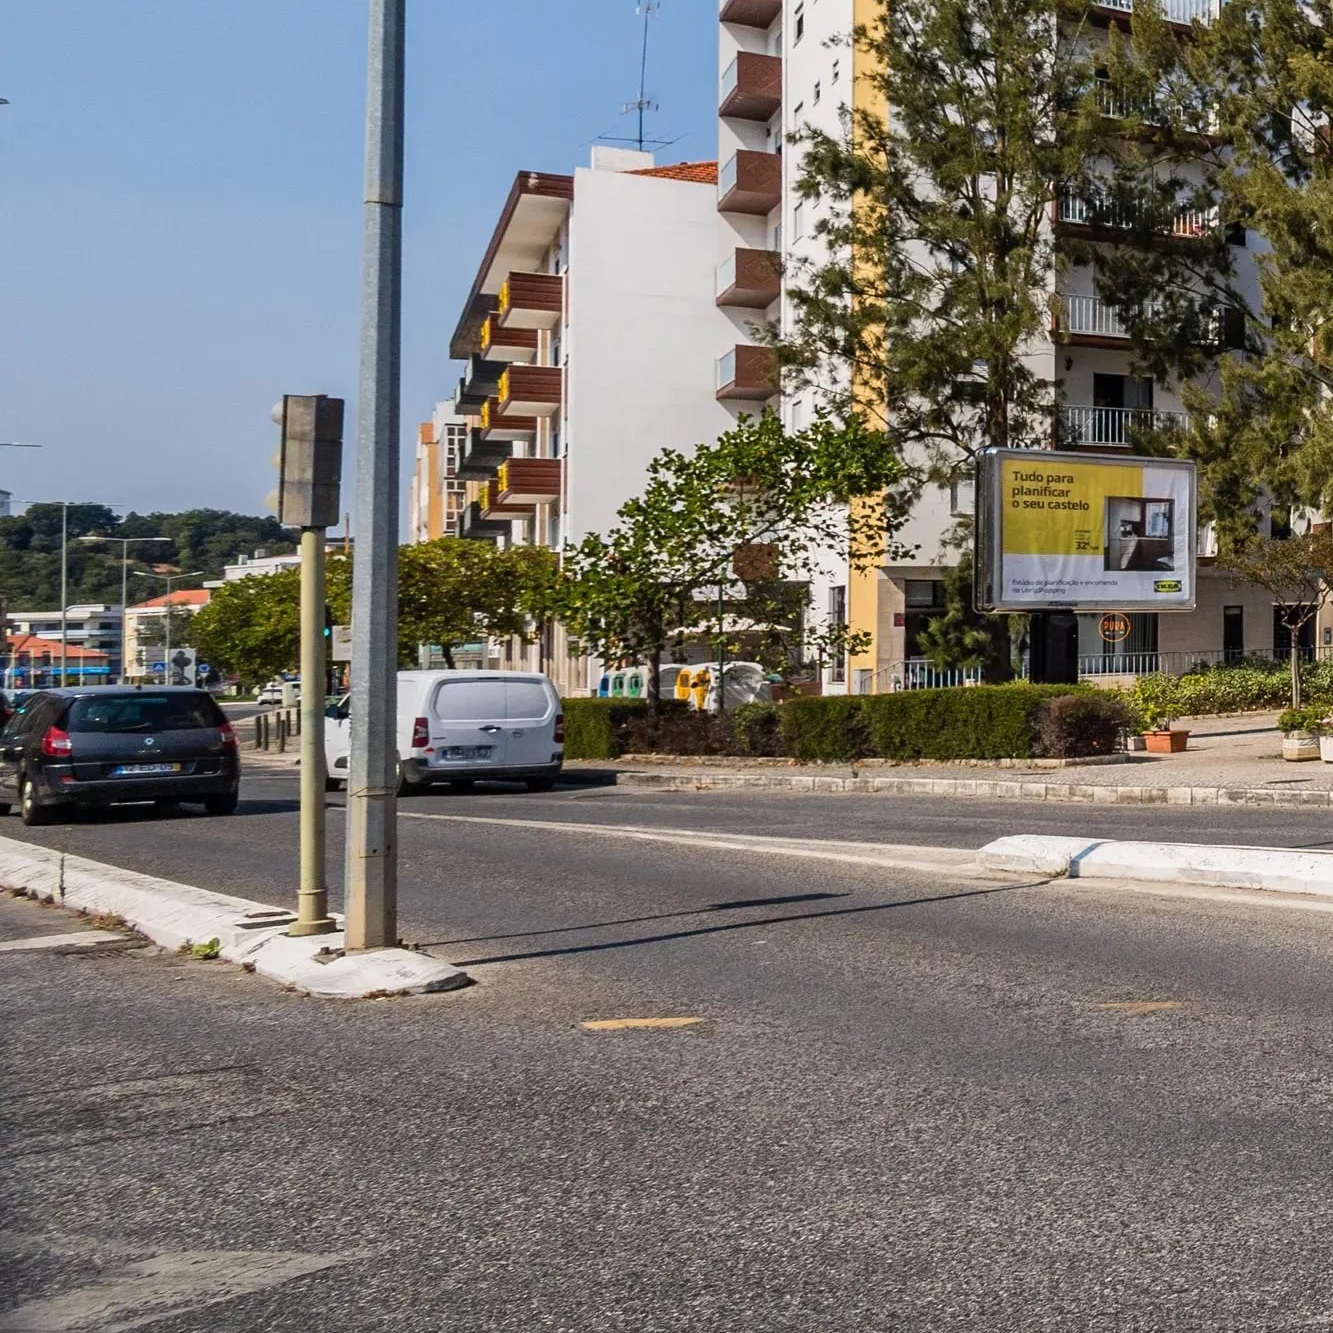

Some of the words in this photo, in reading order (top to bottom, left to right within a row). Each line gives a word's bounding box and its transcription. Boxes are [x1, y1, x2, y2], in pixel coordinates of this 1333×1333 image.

[1012, 471, 1044, 482] Tudo
[1046, 474, 1074, 485] para
[1012, 485, 1071, 498] planificar
[1012, 500, 1020, 509] o
[1022, 500, 1045, 509] seu
[1047, 500, 1090, 511] castelo
